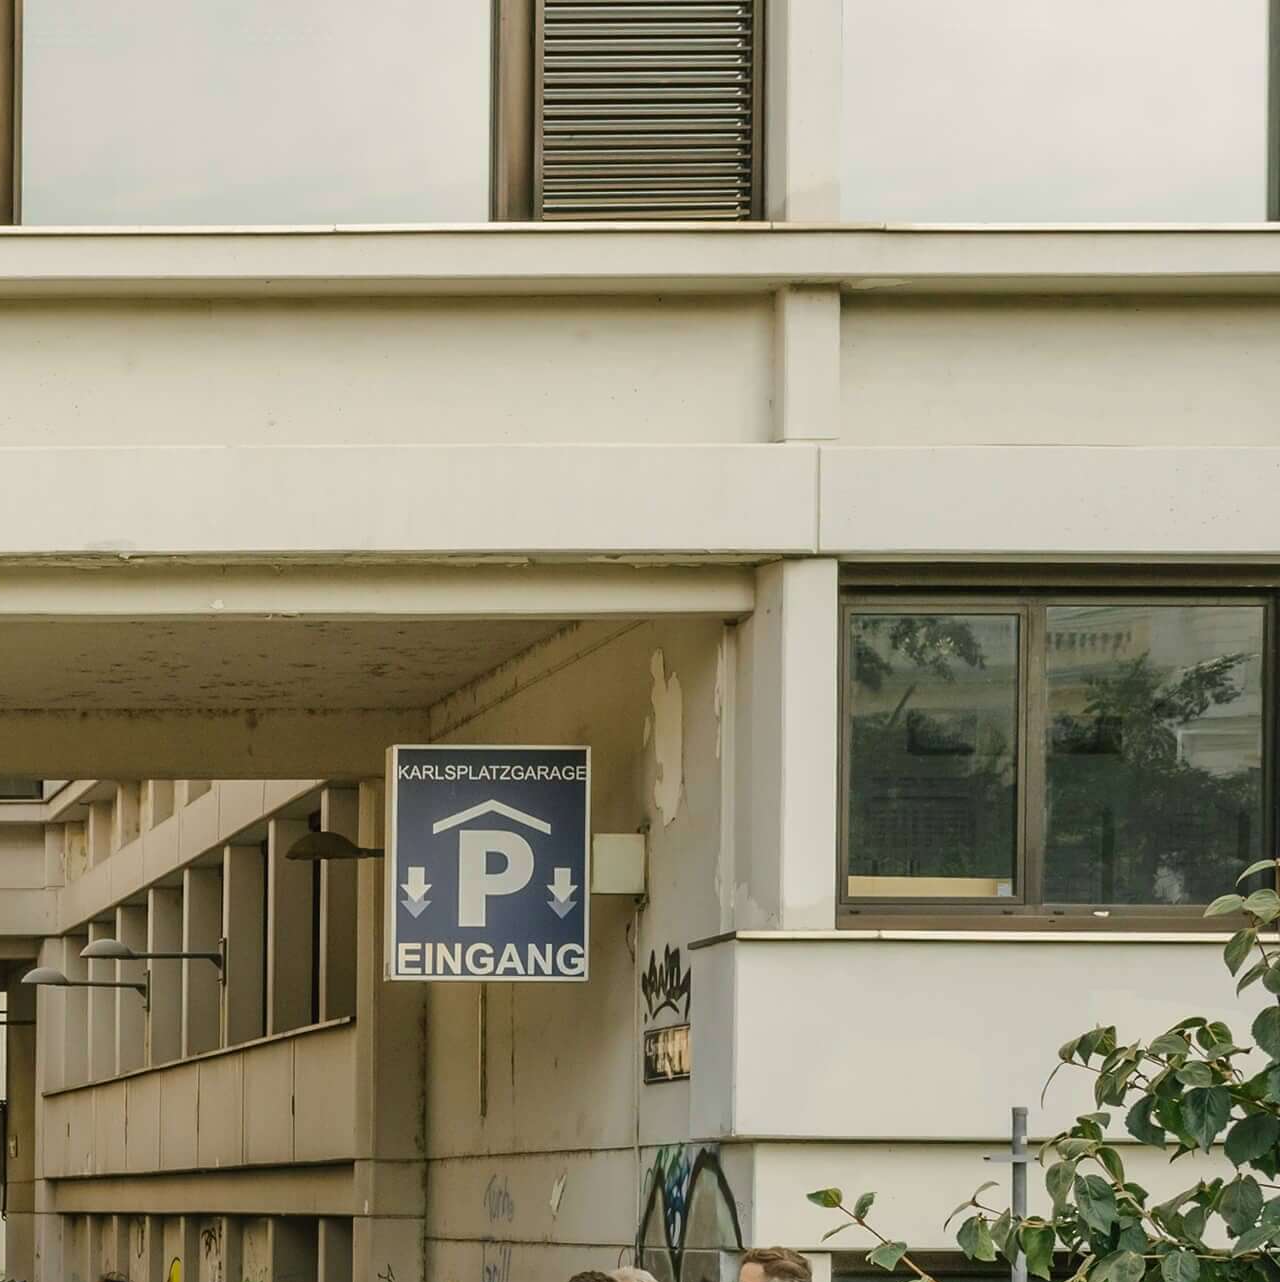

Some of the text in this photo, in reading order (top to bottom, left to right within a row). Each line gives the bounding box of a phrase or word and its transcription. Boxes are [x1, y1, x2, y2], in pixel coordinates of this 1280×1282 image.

[398, 765, 587, 781] KARLSPLATZGARAGE
[458, 830, 535, 927] P
[397, 942, 585, 976] EINGANG
